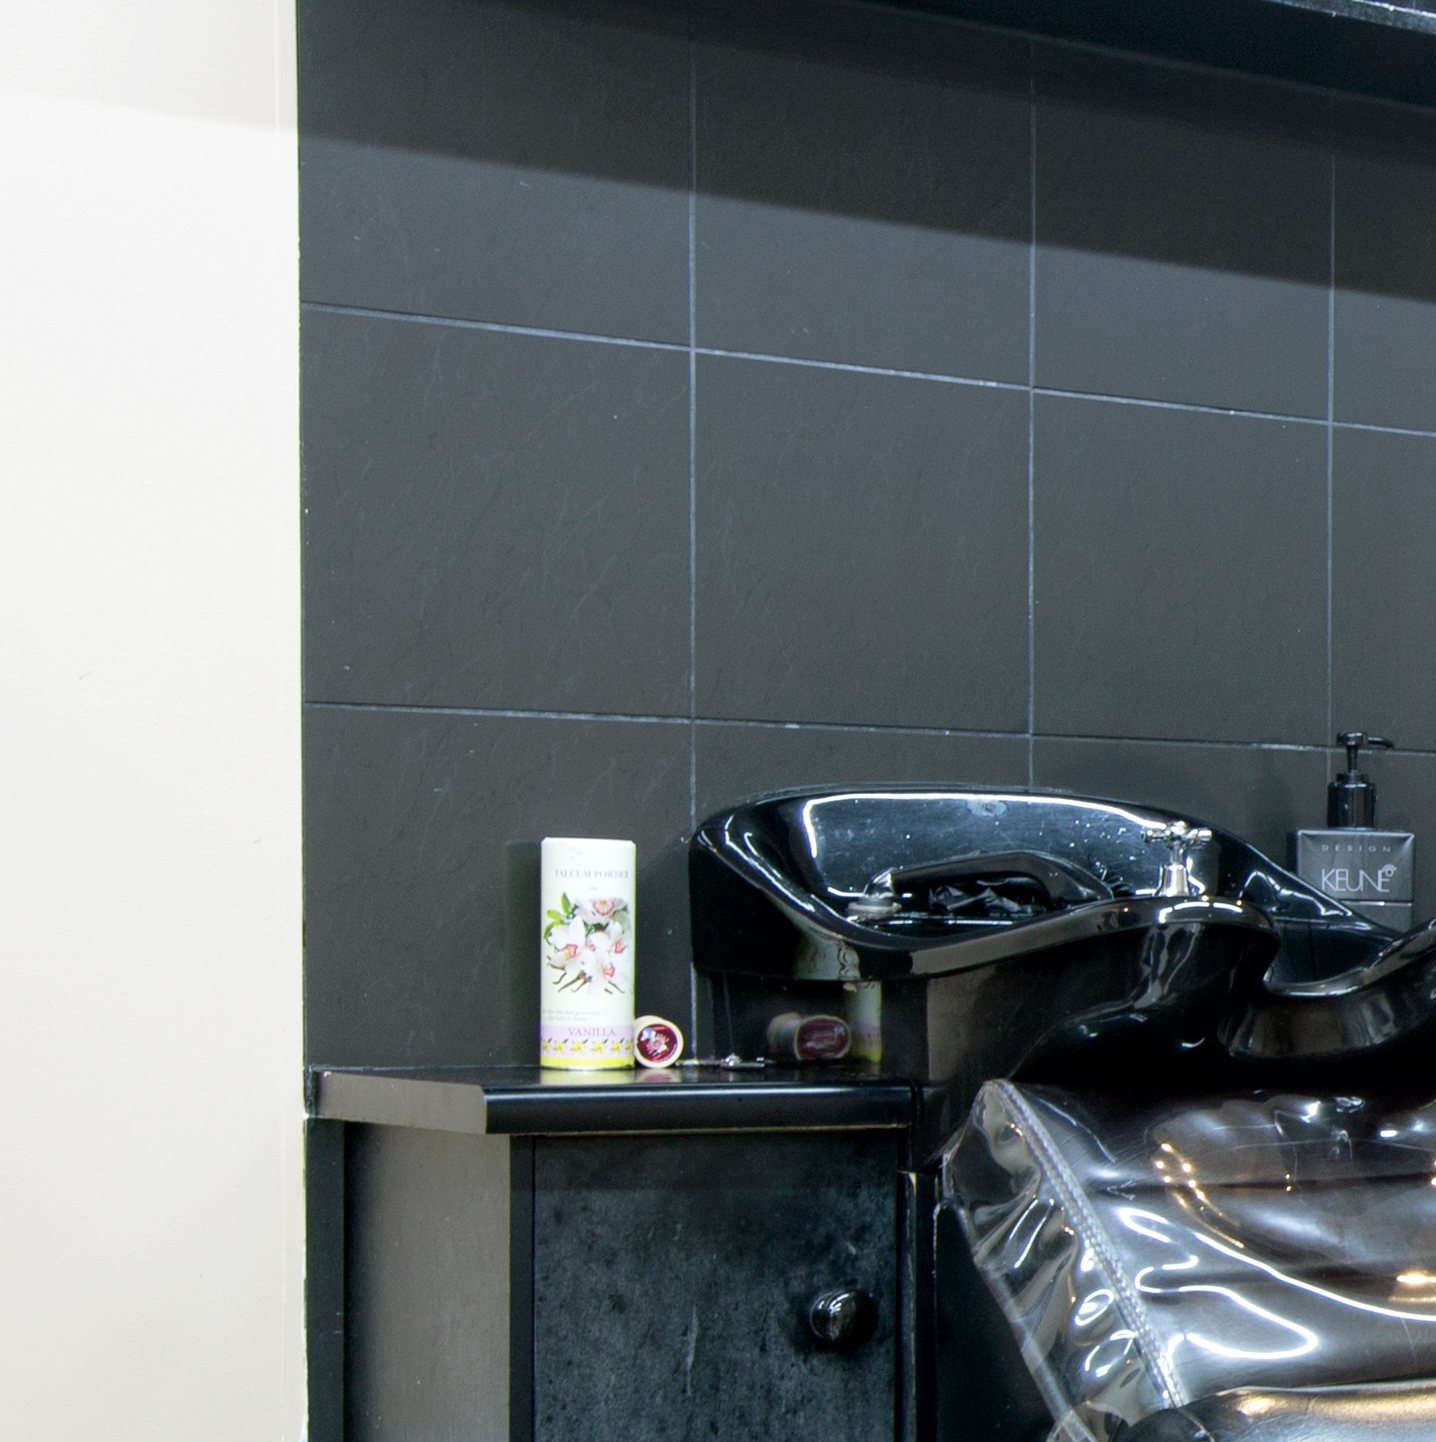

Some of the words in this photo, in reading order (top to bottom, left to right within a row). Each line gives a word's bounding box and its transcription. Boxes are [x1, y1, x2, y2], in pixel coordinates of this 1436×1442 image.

[1321, 844, 1391, 853] DESIGN
[554, 868, 591, 879] TALCUM
[1321, 867, 1392, 893] KEUNE
[568, 1027, 616, 1037] VANILLA
